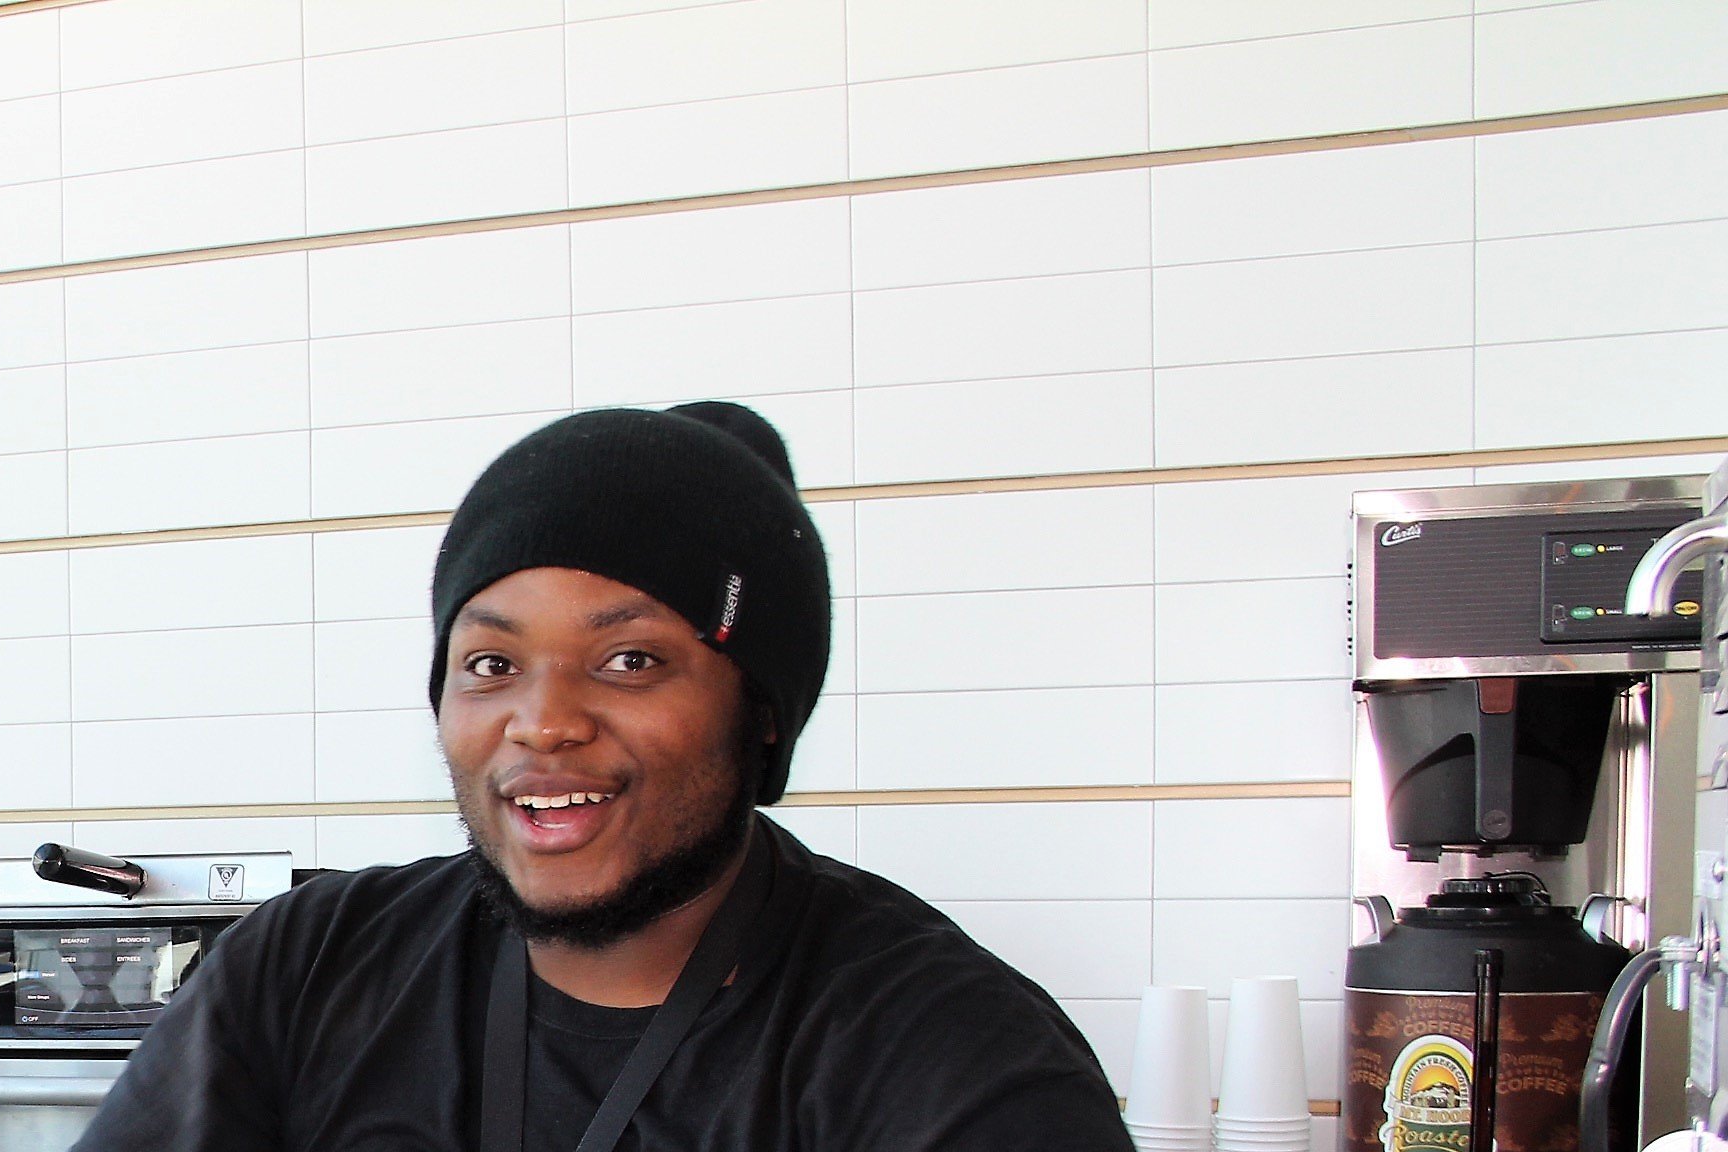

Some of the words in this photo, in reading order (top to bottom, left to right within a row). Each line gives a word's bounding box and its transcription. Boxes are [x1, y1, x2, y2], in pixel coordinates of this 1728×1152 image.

[1381, 524, 1421, 546] Curtis
[1427, 1057, 1457, 1071] FRESH
[1383, 1125, 1470, 1151] Roaste
